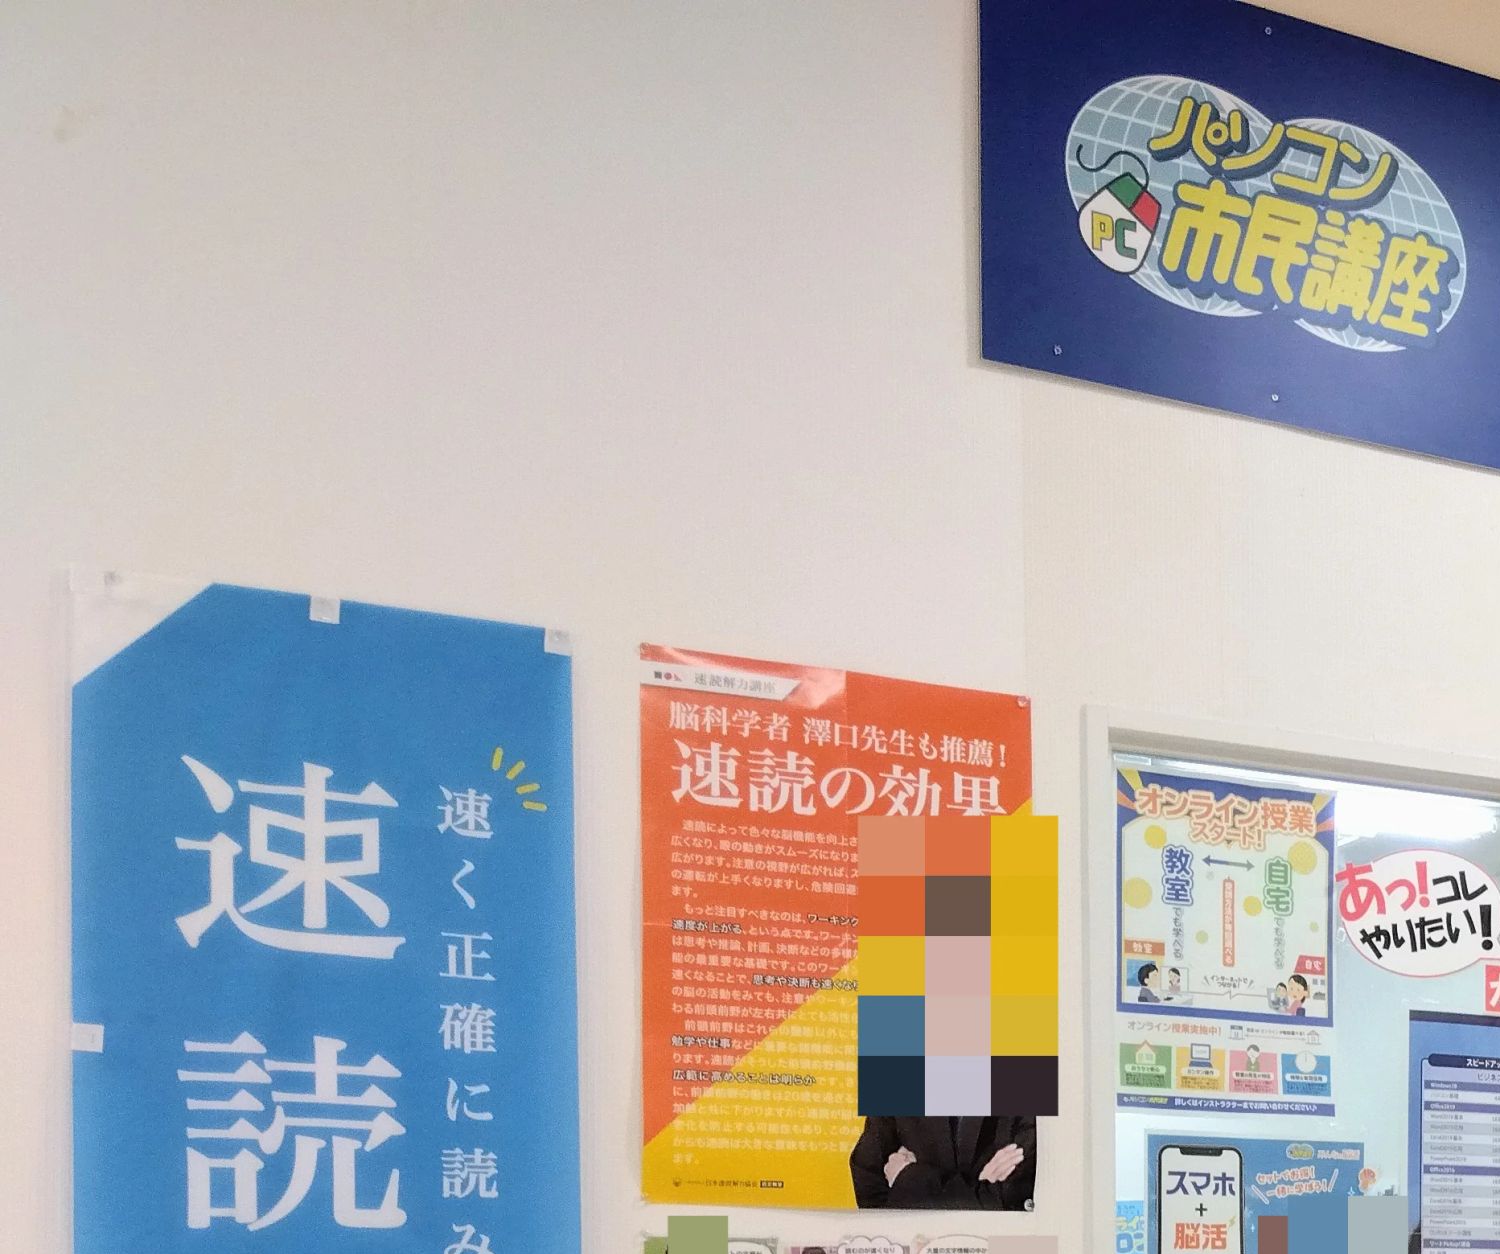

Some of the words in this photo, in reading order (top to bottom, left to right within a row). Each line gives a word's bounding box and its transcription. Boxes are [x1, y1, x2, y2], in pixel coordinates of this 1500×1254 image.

[1149, 97, 1392, 201] パソコン
[1091, 210, 1137, 259] PC
[1163, 178, 1449, 338] 市民講座
[669, 701, 791, 742] 脳科学者
[802, 718, 1007, 768] 澤口先生も推薦！
[671, 739, 1006, 816] 速読の効果
[1136, 785, 1316, 836] オンライン授業
[1191, 822, 1265, 850] スタート！
[1360, 904, 1494, 959] やりたい！
[1166, 1170, 1236, 1197] スマホ
[1174, 1223, 1228, 1250] 脳活
